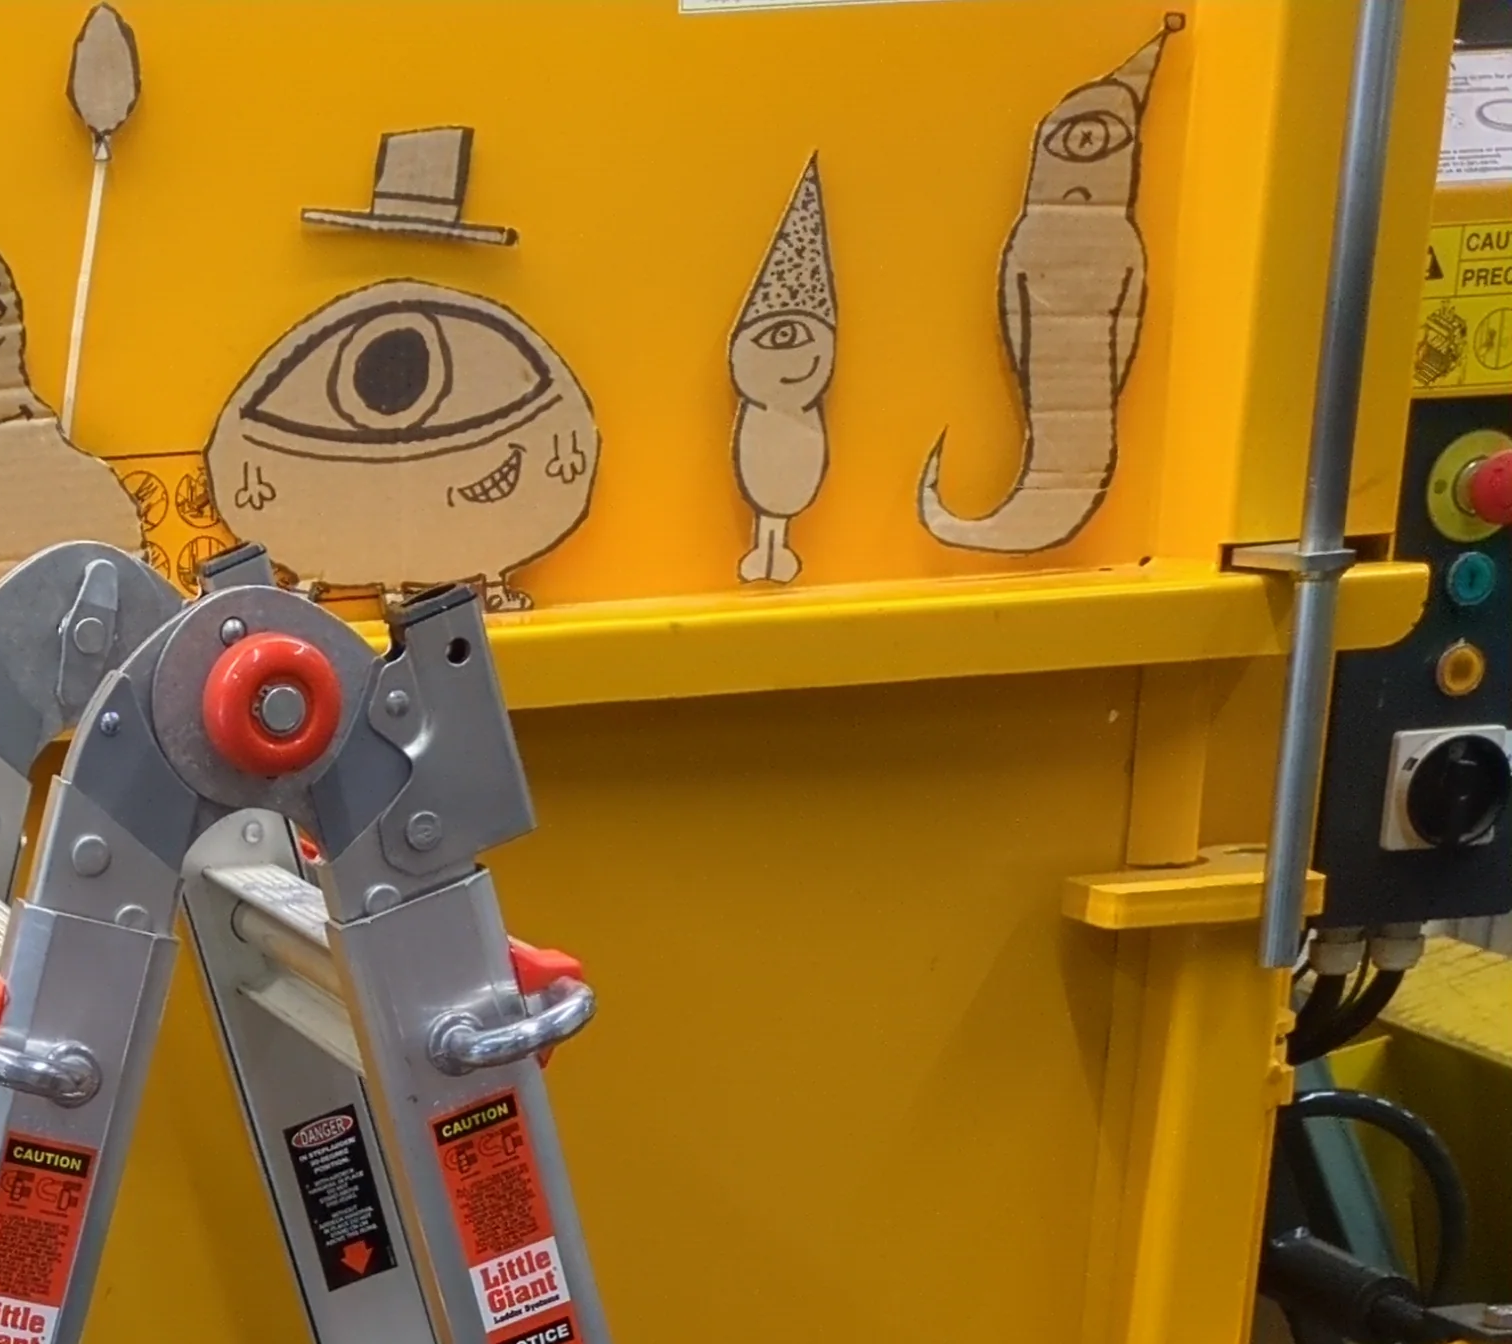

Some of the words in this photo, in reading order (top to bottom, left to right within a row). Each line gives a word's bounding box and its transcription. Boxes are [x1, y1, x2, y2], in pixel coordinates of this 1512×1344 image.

[1466, 230, 1512, 252] CAU
[299, 1117, 346, 1147] DANGER
[442, 1103, 509, 1138] CAUTION
[12, 1146, 83, 1171] CAUTION
[480, 1250, 552, 1291] Little
[487, 1271, 558, 1315] Giant
[493, 1306, 523, 1325] Ladder
[525, 1293, 561, 1314] Systems
